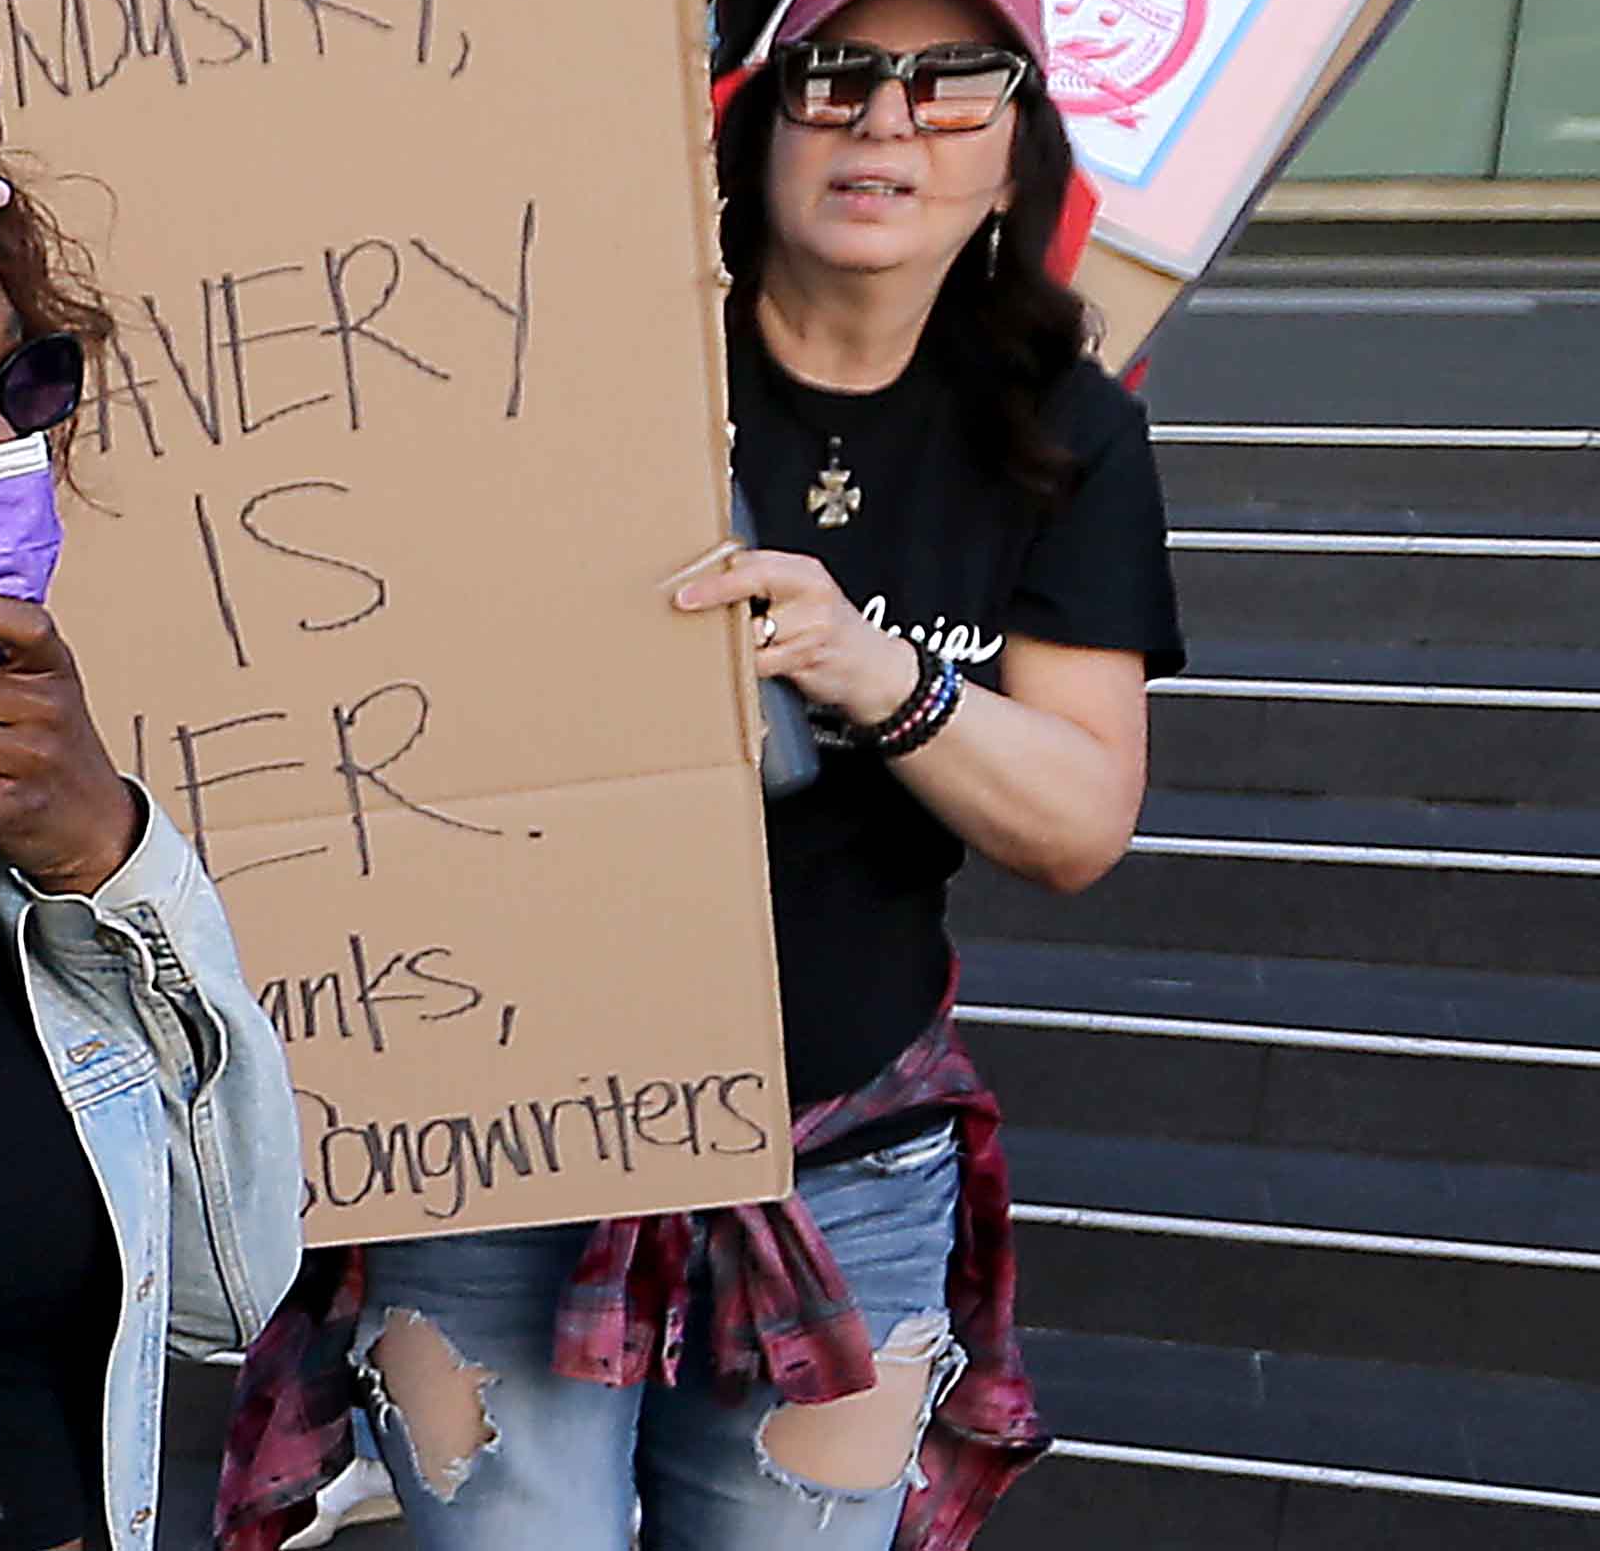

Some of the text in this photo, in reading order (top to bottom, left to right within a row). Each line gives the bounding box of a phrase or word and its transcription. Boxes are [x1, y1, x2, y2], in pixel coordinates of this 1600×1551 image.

[78, 199, 537, 457] AVERY
[195, 482, 387, 668] IS
[257, 934, 517, 1053] anks,
